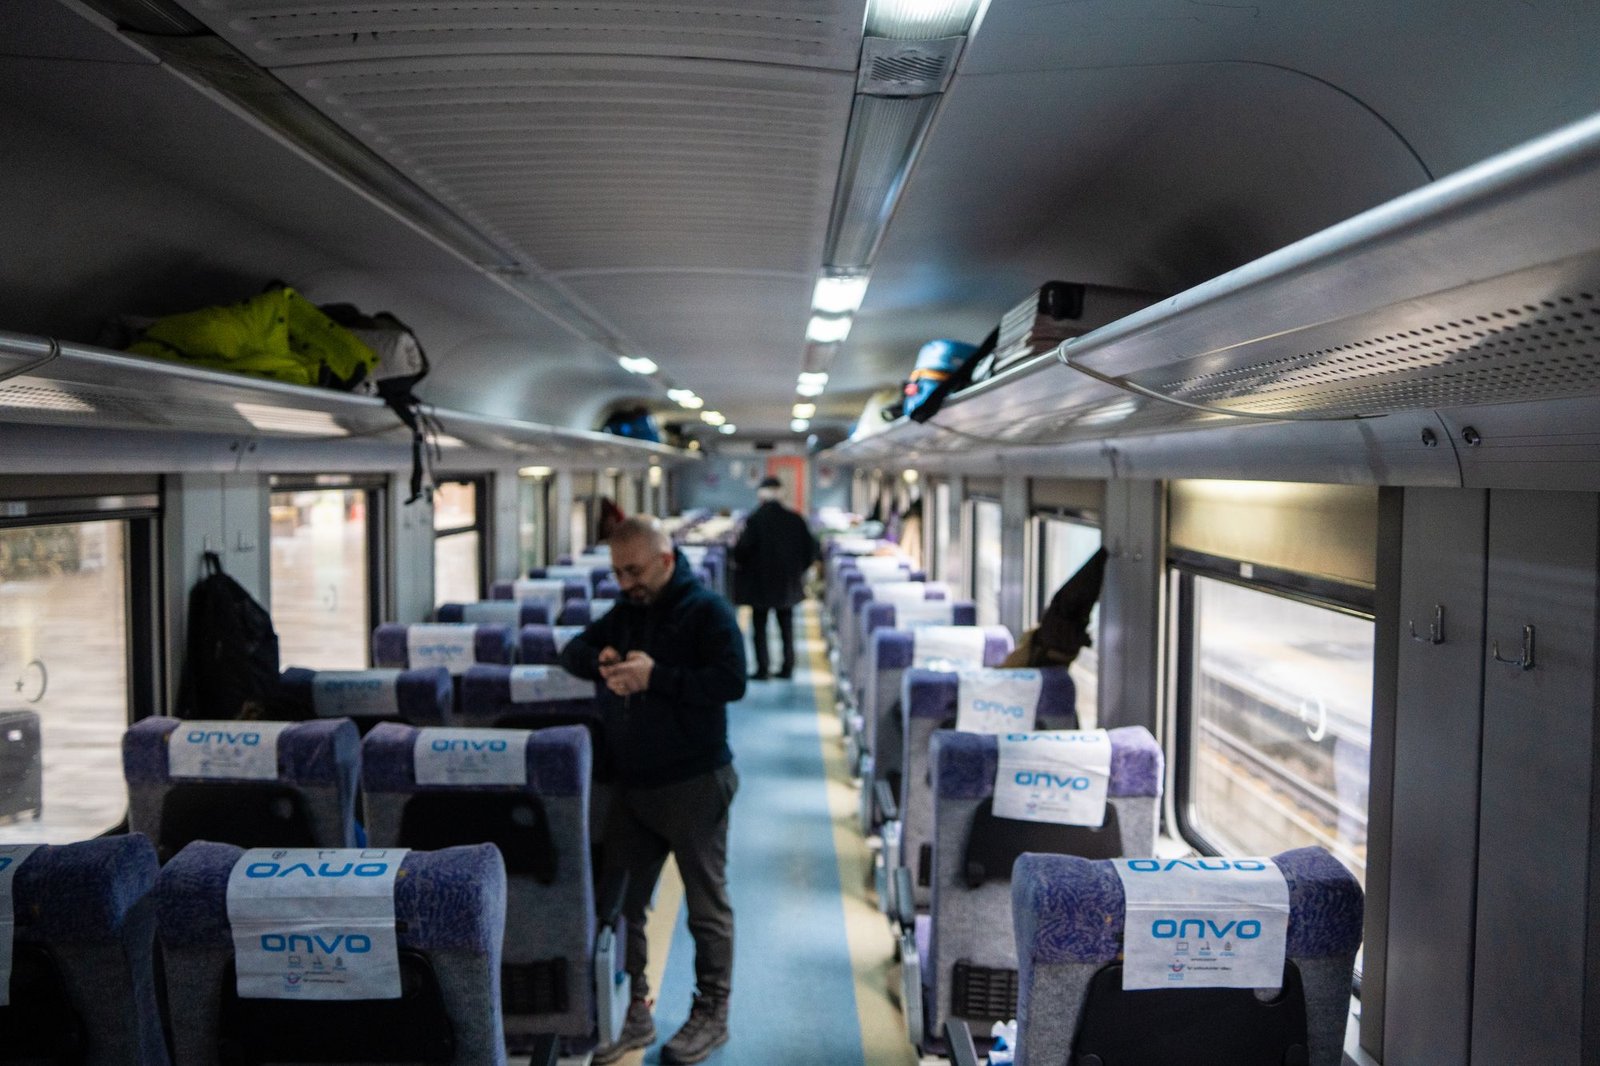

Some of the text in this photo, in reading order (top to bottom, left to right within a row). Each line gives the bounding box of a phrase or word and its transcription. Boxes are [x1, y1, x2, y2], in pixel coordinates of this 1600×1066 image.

[187, 731, 261, 747] onvo
[431, 738, 507, 753] onvo
[1014, 770, 1090, 791] onvo
[246, 862, 389, 879] onvo
[1127, 859, 1267, 873] onvo
[1151, 919, 1262, 940] onvo
[261, 934, 372, 955] onvo
